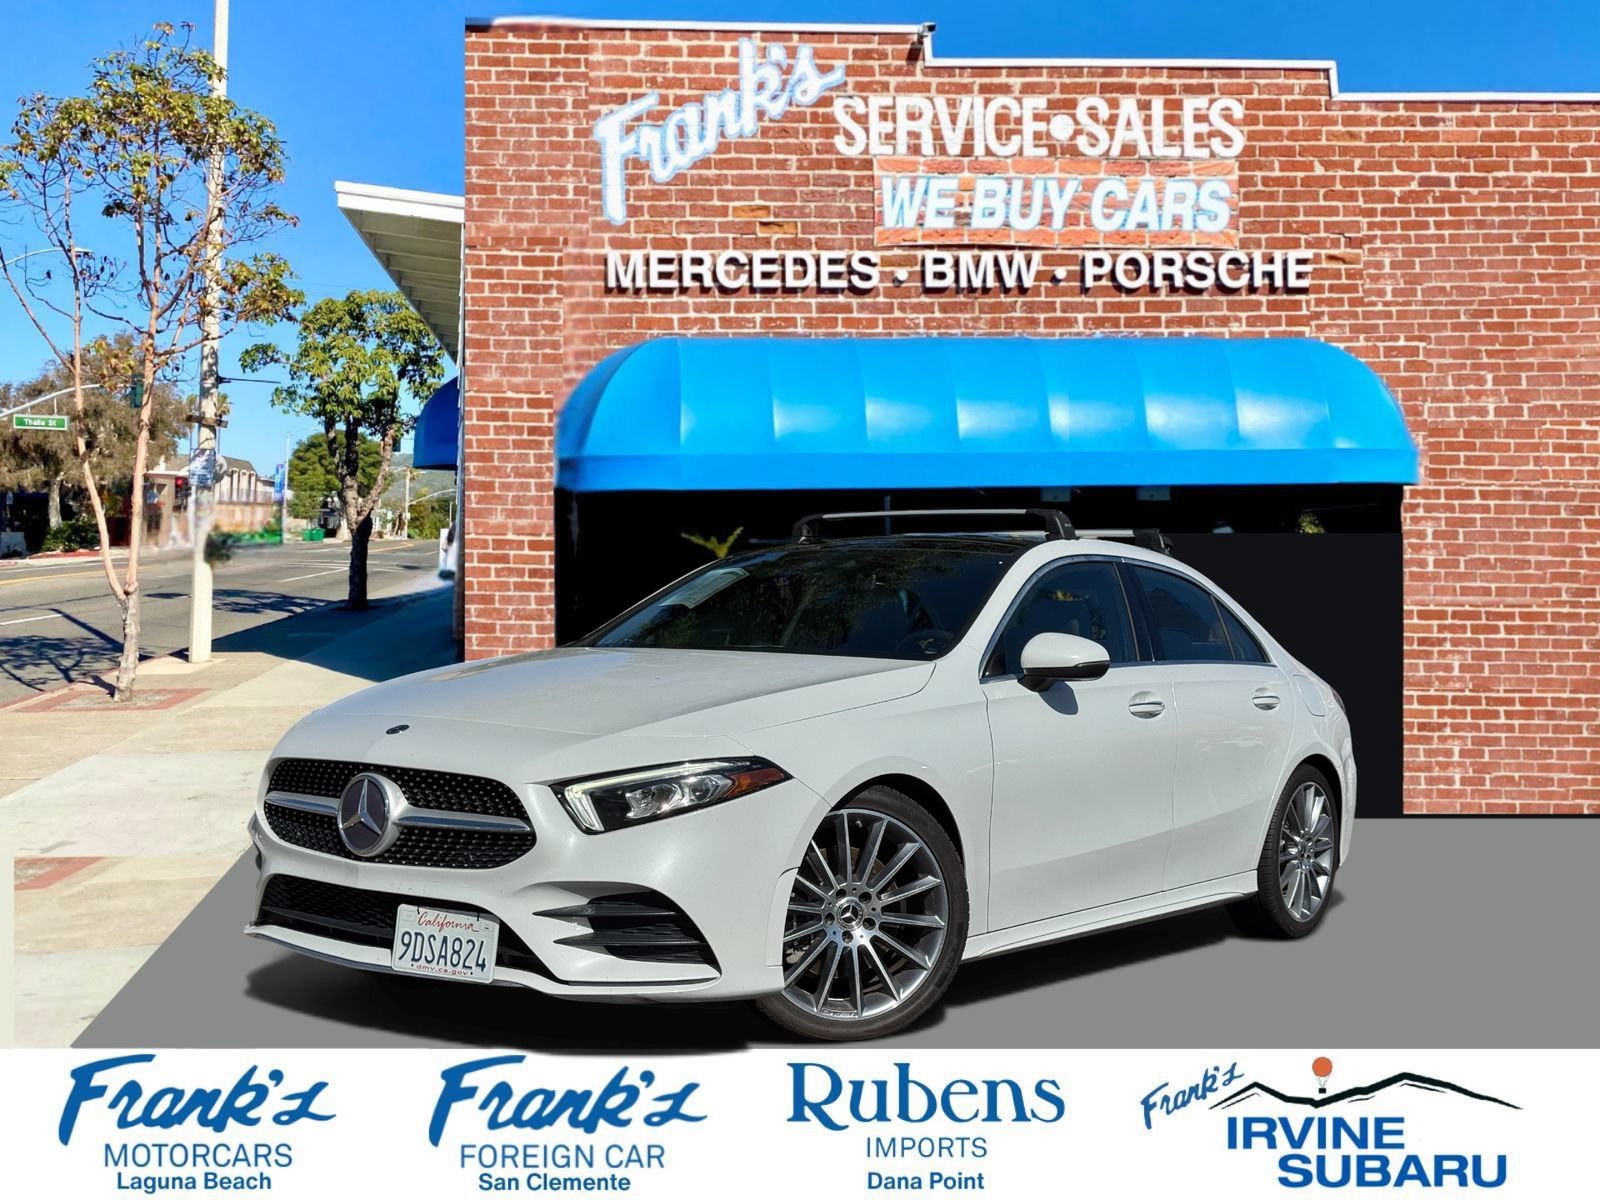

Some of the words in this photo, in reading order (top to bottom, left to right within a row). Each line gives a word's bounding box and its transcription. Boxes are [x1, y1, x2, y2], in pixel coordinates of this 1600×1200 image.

[593, 37, 846, 225] Frank's
[1075, 97, 1245, 158] SALES
[881, 175, 960, 230] WE
[970, 176, 1082, 231] BUY
[1090, 178, 1232, 233] CARS
[604, 250, 881, 292] MERCEDES
[922, 250, 1042, 292] BMW
[1082, 250, 1314, 292] PORSCHE
[418, 911, 480, 933] California
[398, 930, 487, 972] 9DSA824
